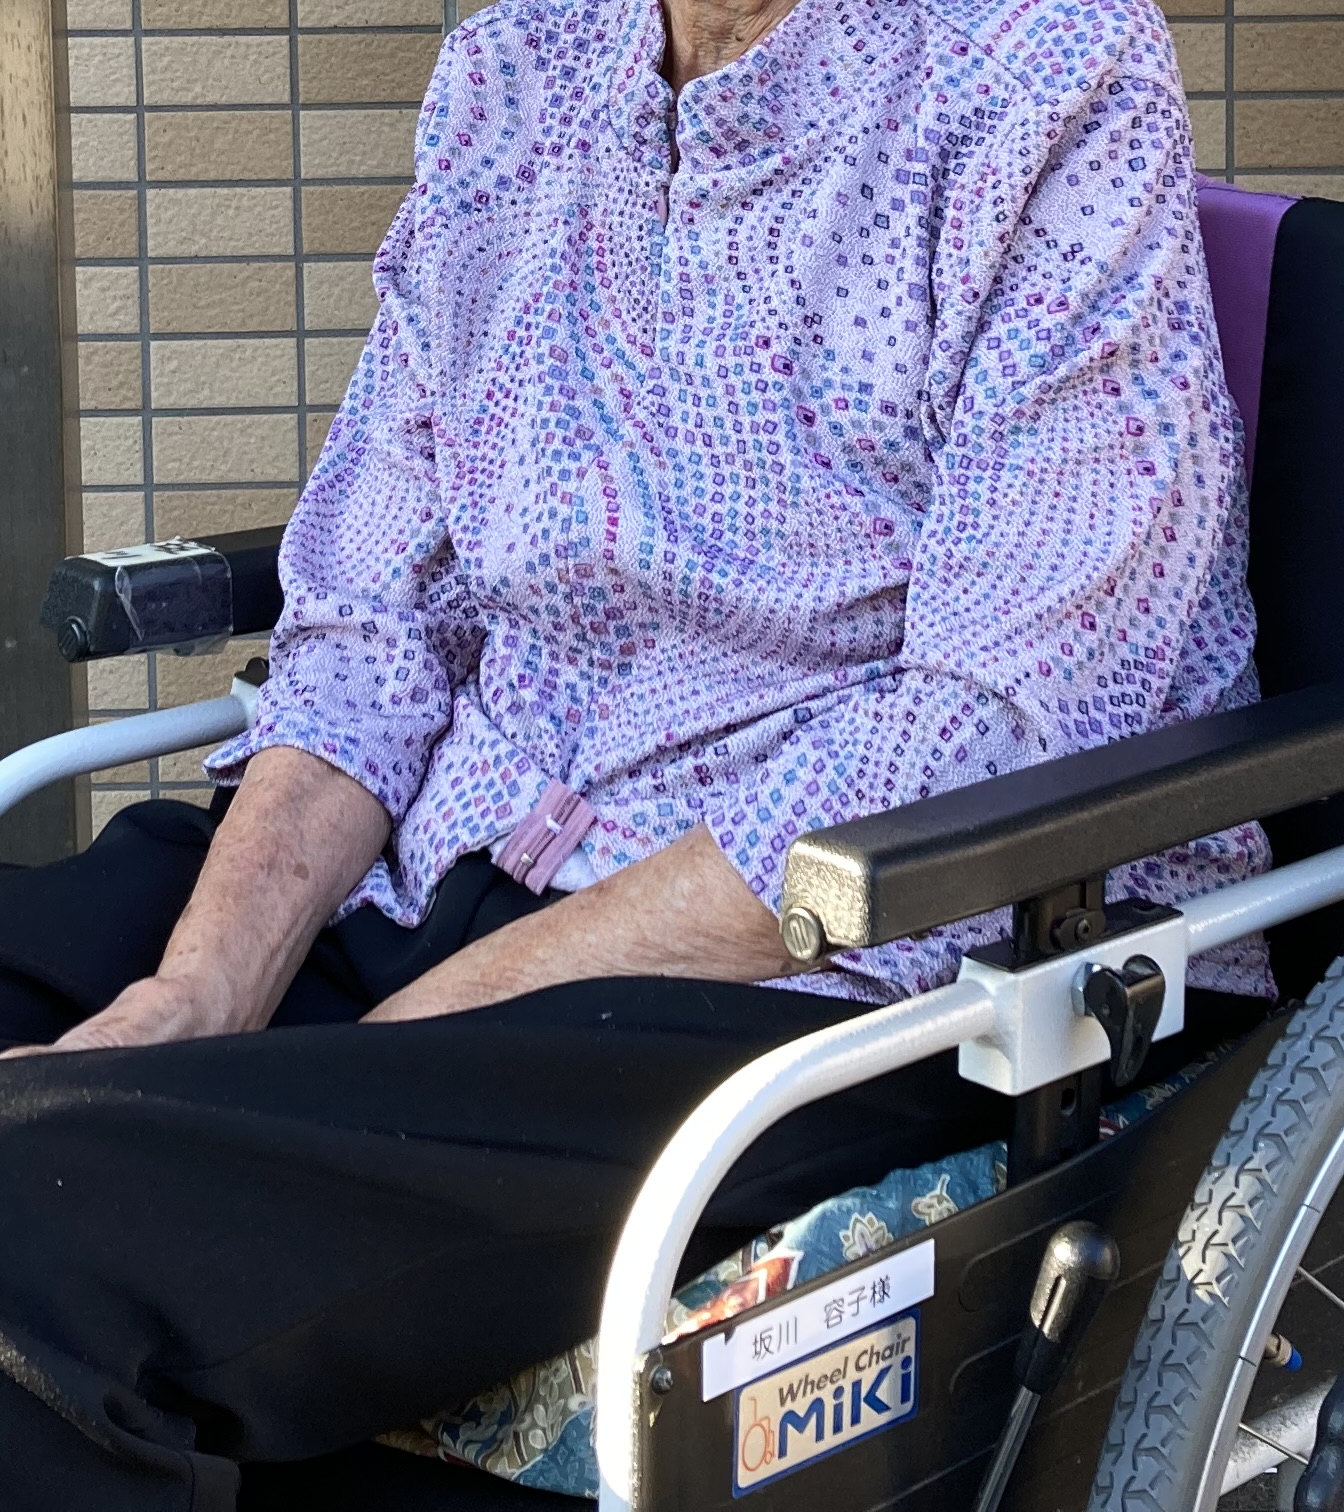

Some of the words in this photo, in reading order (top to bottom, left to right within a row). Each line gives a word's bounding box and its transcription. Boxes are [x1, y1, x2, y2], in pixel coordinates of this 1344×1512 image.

[751, 1316, 798, 1361] 坂川
[778, 1355, 849, 1408] Wheel
[854, 1332, 911, 1373] Chair
